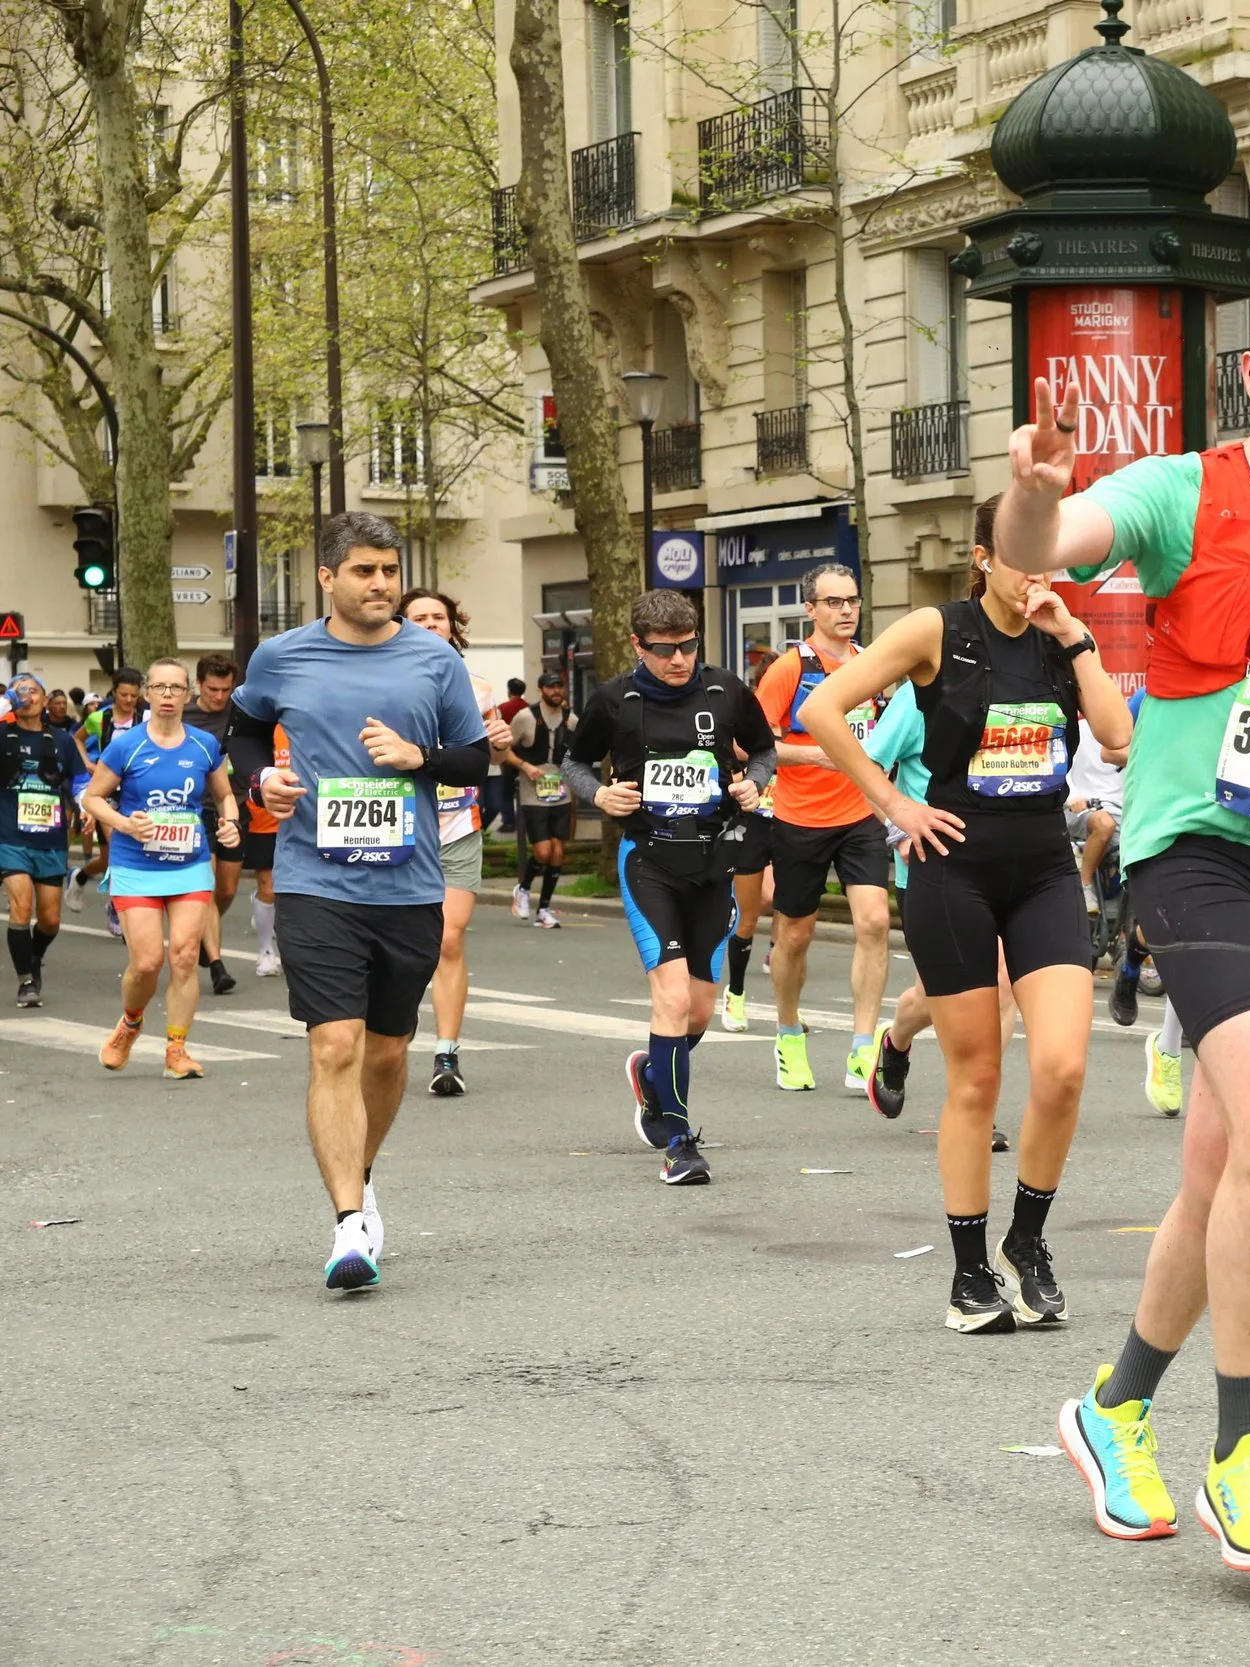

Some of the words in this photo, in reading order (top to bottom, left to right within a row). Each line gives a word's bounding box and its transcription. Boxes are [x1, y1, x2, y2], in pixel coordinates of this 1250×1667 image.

[1056, 238, 1139, 256] THEATRES
[1192, 242, 1242, 263] THEATRES
[1071, 302, 1113, 315] STUDIO
[1075, 315, 1131, 327] MARIGNY
[1047, 354, 1167, 407] FANNY
[1056, 403, 1173, 455] DANT
[664, 548, 692, 562] MOLI
[718, 535, 746, 567] MOLI
[697, 733, 715, 741] Open
[982, 759, 1008, 769] Leonor
[1010, 760, 1040, 769] Roberto
[650, 763, 706, 788] 22834
[339, 779, 399, 790] Schneider
[366, 788, 398, 796] Electric
[22, 803, 52, 817] 75263
[327, 799, 397, 828] 27264
[154, 825, 190, 842] 72817
[343, 836, 381, 845] Henrique
